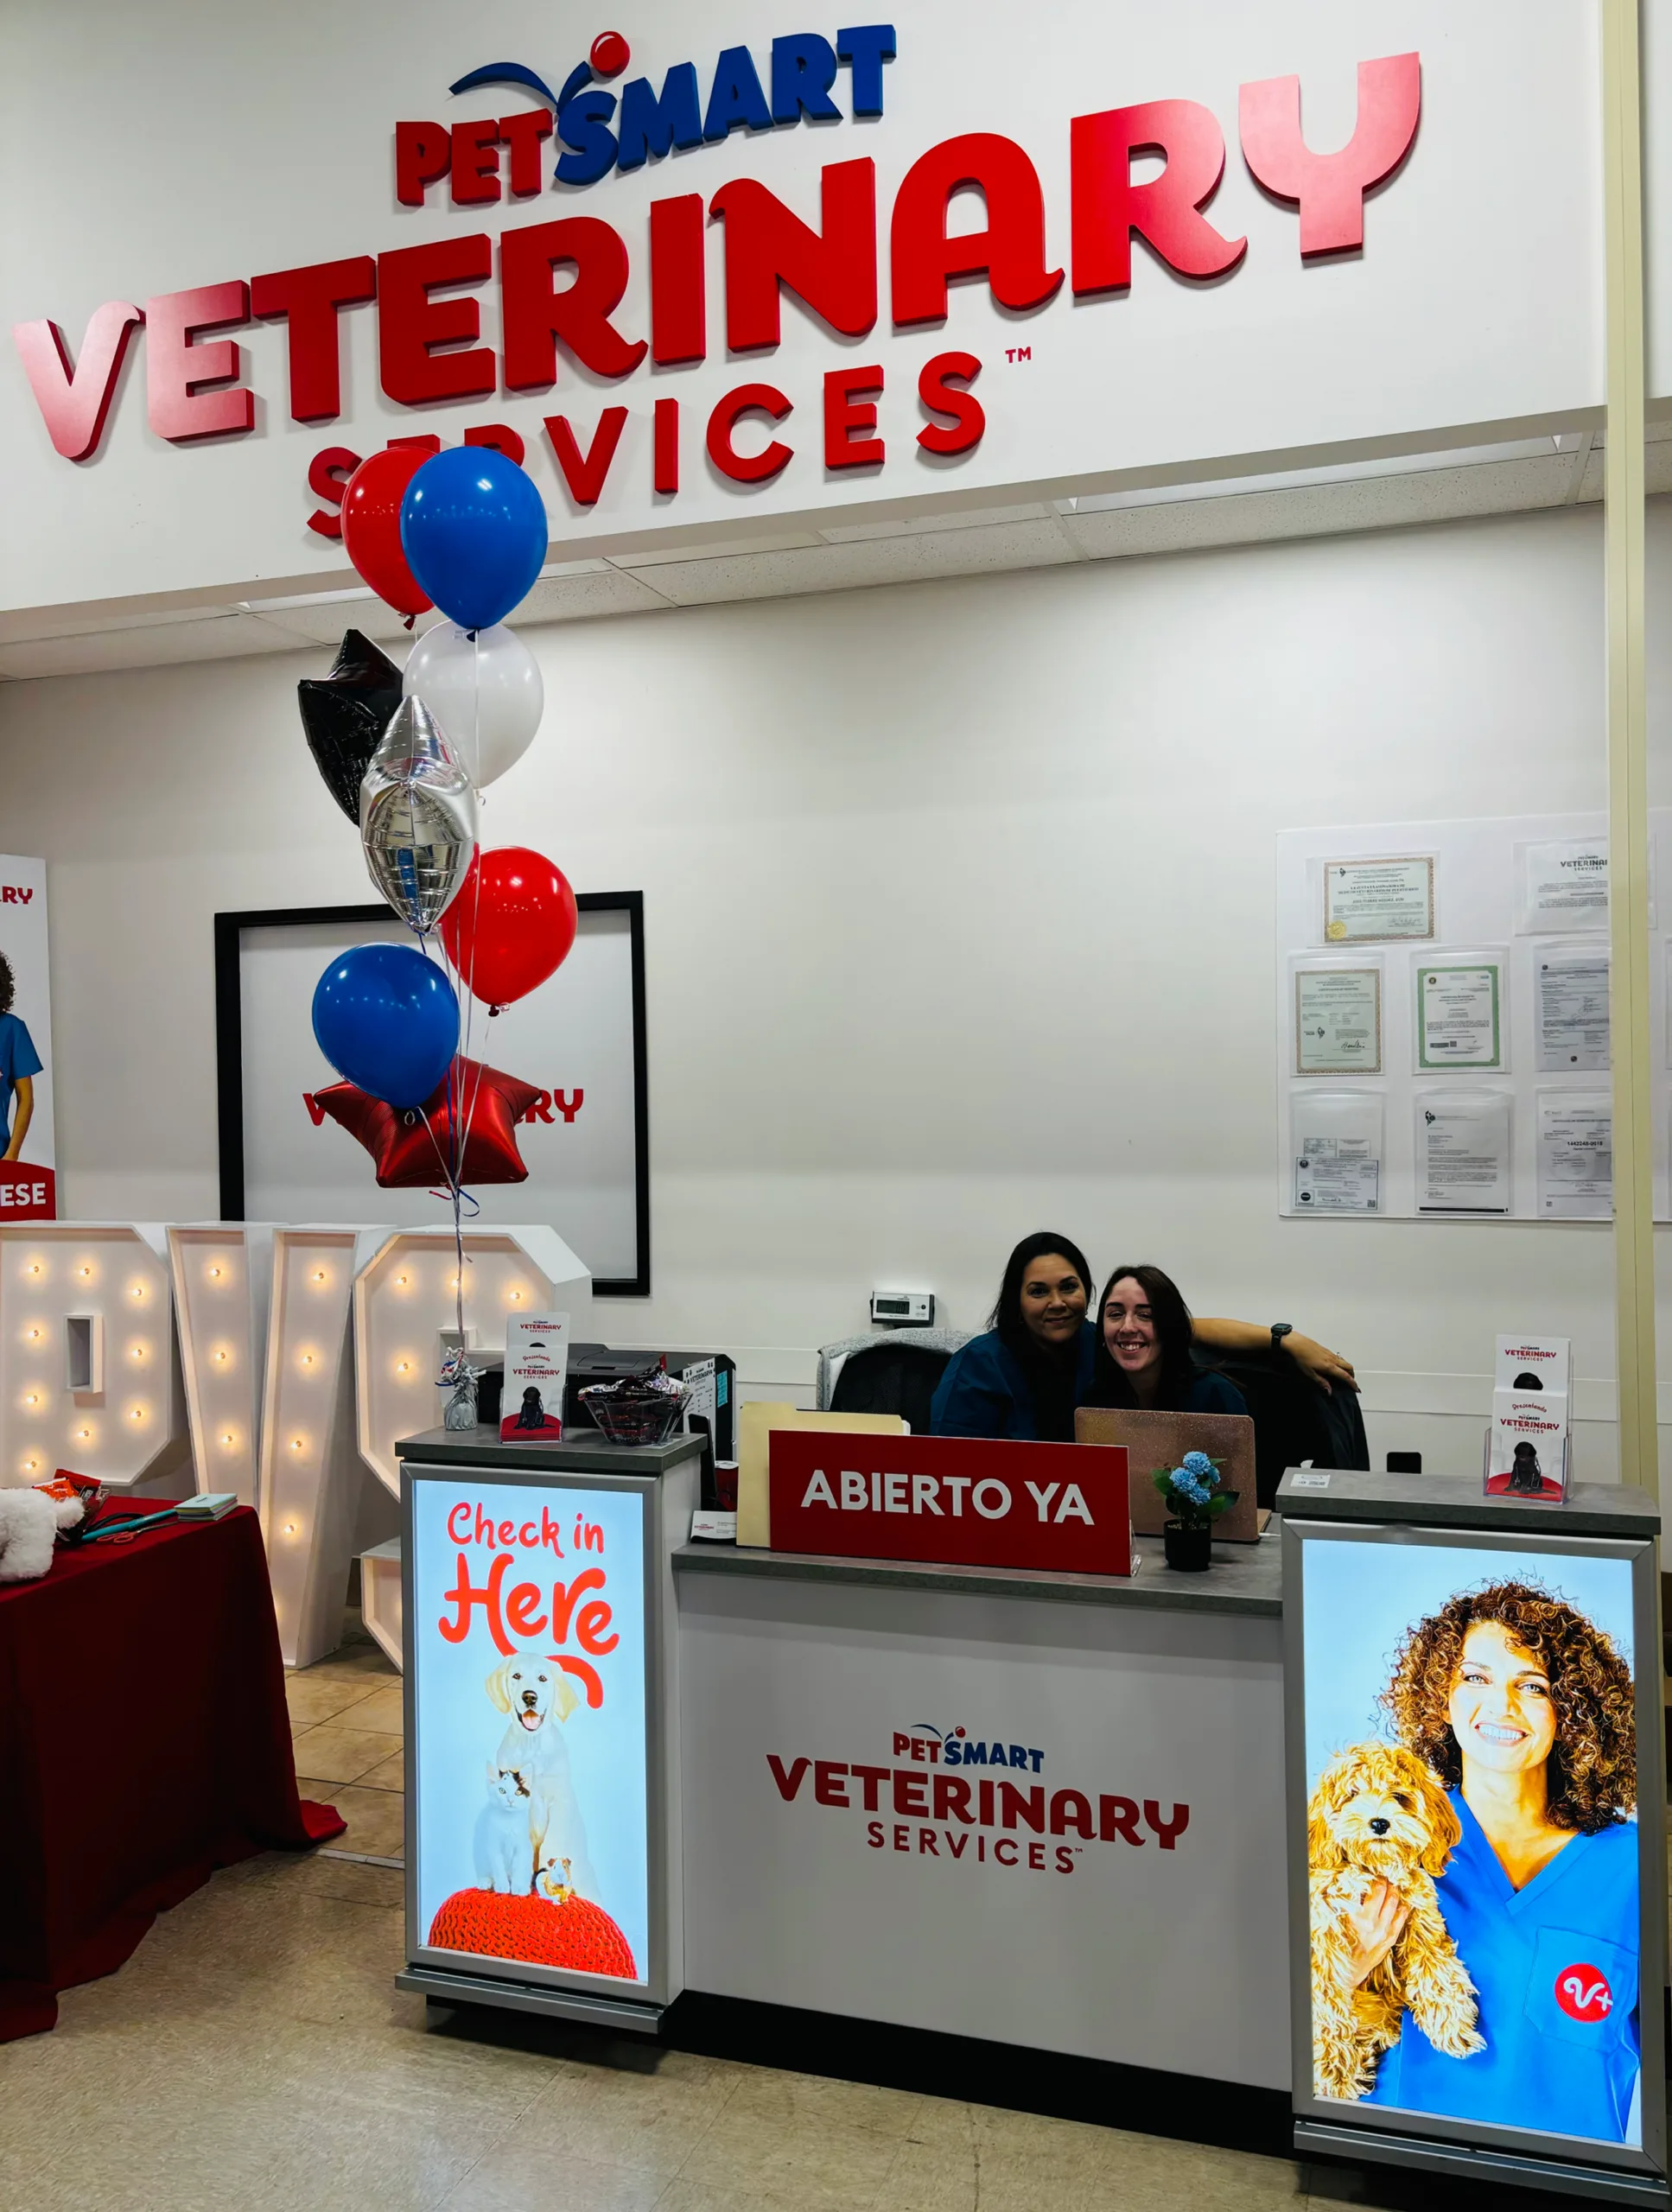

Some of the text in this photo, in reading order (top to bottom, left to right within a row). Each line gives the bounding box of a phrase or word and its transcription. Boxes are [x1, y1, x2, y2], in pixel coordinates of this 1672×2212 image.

[395, 24, 896, 207] PETSMART
[12, 52, 1421, 462] VETERINARY
[307, 350, 987, 539] SVICES
[1500, 1419, 1560, 1430] VETERINARY
[447, 1502, 605, 1559] Check in
[800, 1469, 1095, 1526] ABIERTO YA
[438, 1552, 620, 1668] Here
[893, 1726, 1045, 1774] PETSMART
[766, 1754, 1190, 1851] VETERINARY
[867, 1821, 1074, 1874] SERVICES
